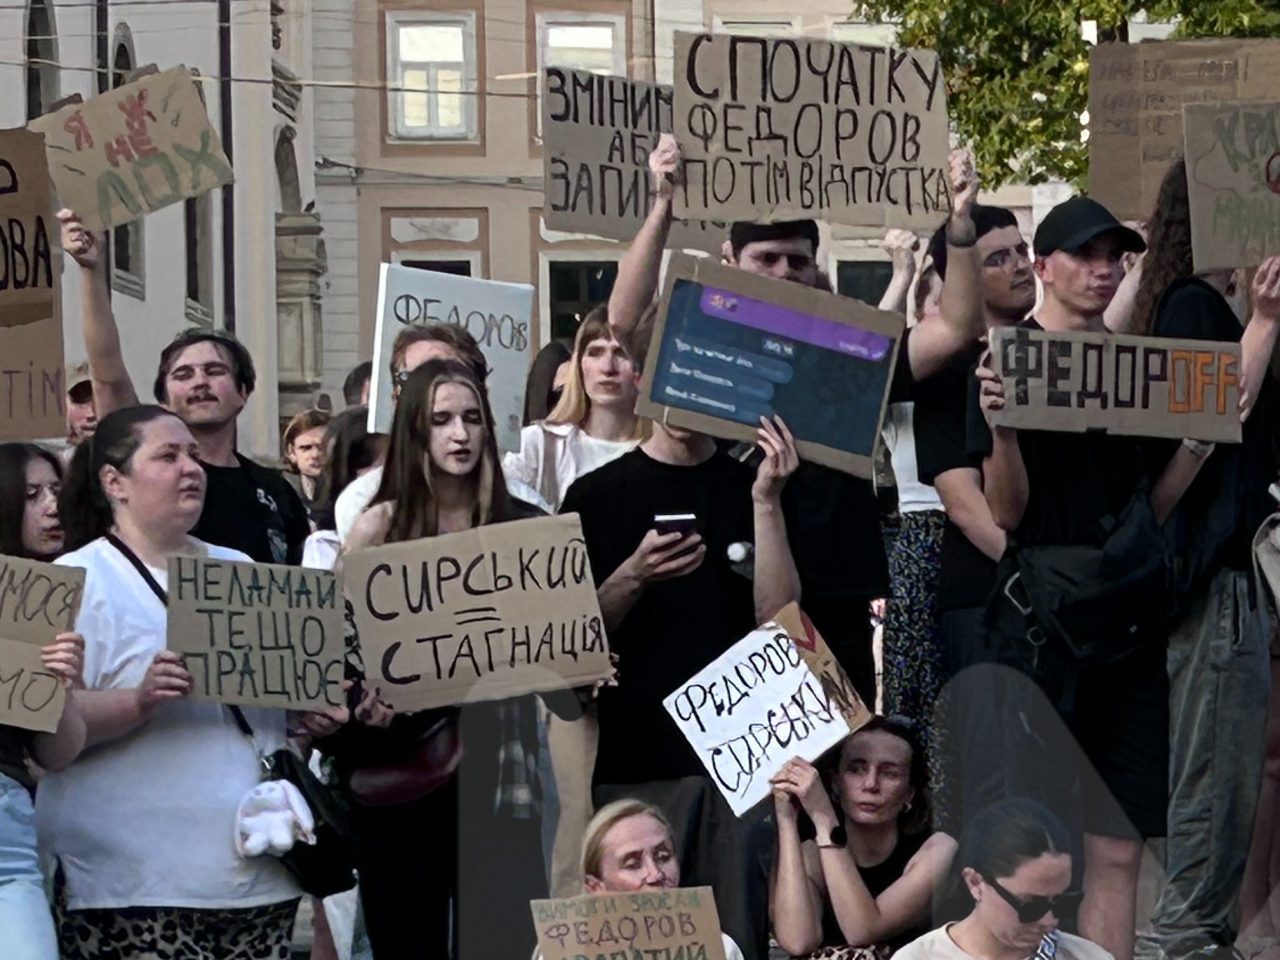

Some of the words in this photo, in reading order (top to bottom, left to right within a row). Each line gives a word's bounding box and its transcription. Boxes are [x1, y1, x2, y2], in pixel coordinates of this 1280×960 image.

[64, 109, 93, 150] Я
[608, 130, 658, 166] АБ
[688, 103, 921, 164] ФЕДОРОВ
[683, 155, 791, 208] ПОТІМ
[800, 155, 951, 215] ВІДПУСТКА
[366, 538, 588, 620] СИРСЬКИЙ
[183, 650, 342, 706] ПРАЦЮЄ
[381, 614, 604, 685] СТАГНАЦІЯ
[674, 633, 801, 732] ФЕДОРОВ
[544, 912, 697, 949] ФЕДОРОВ
